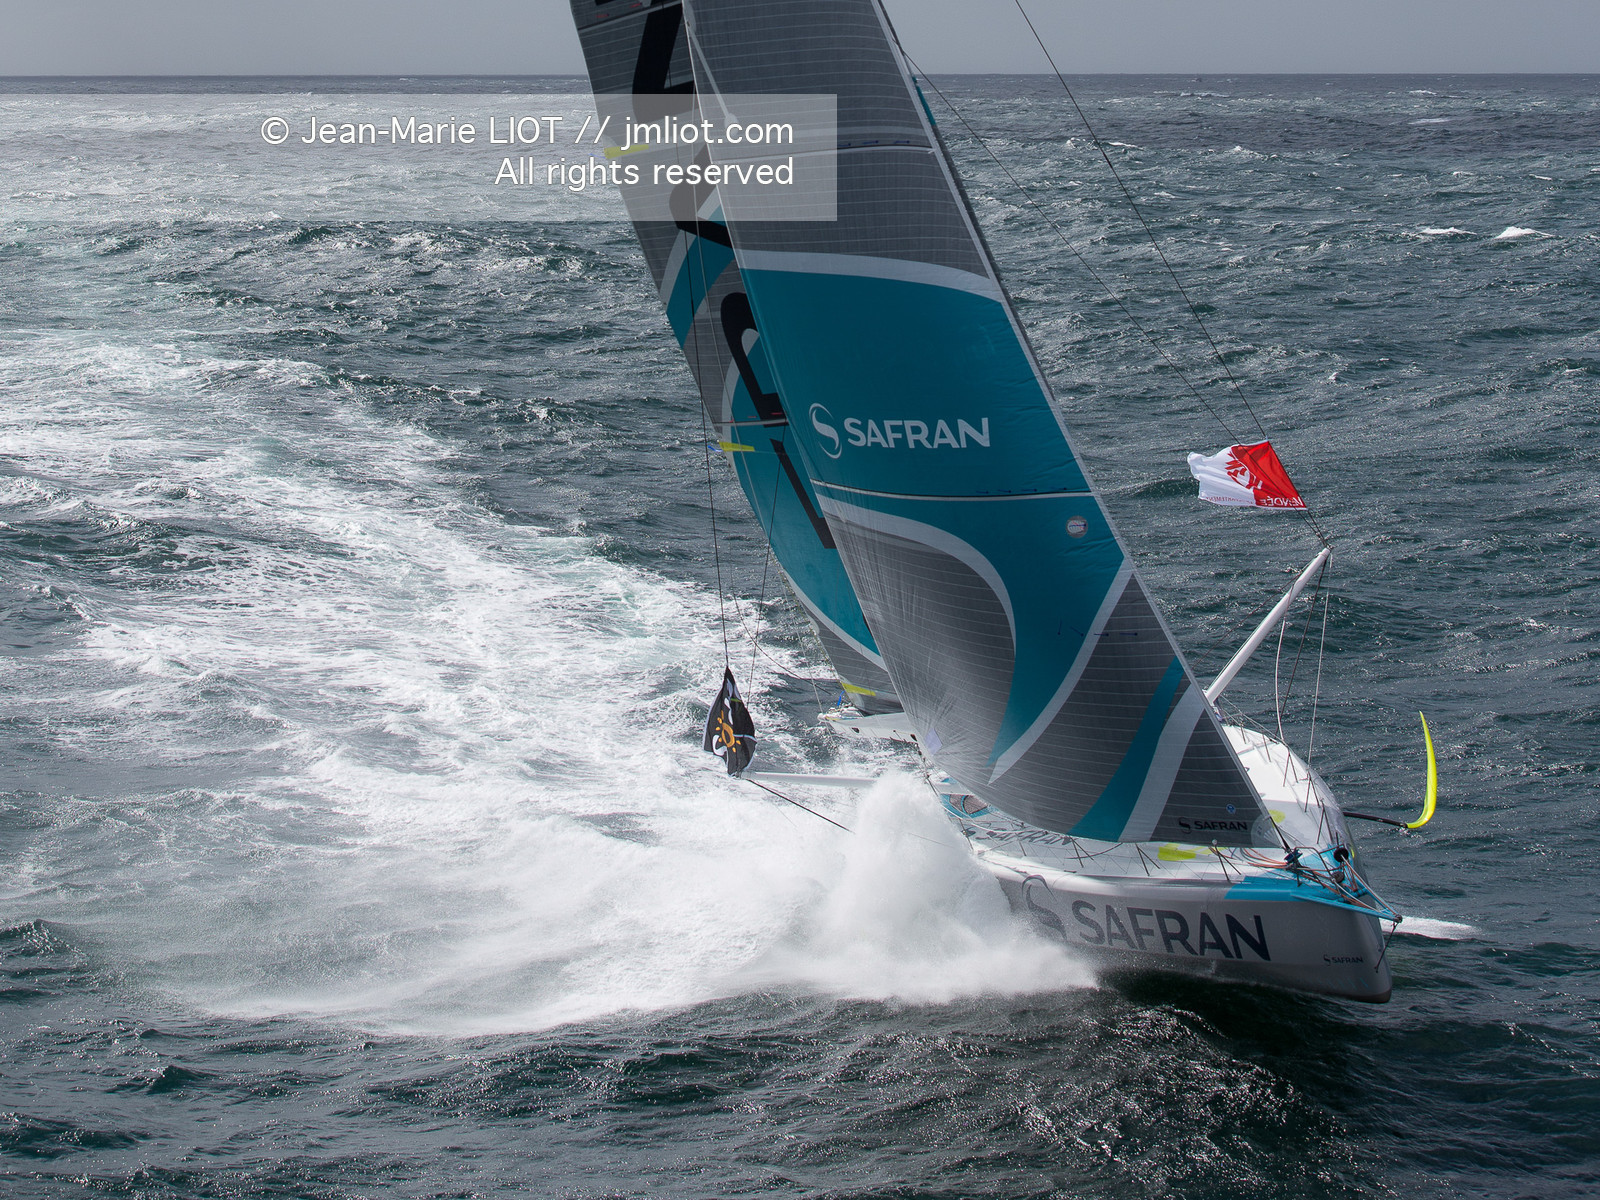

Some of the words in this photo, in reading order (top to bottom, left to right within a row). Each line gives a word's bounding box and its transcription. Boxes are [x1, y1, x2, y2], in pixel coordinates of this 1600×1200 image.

[843, 417, 990, 449] SAFRAN
[1193, 819, 1248, 832] SAFRAN
[1071, 899, 1271, 962] SAFRAN
[1331, 955, 1364, 964] SAFRAN
